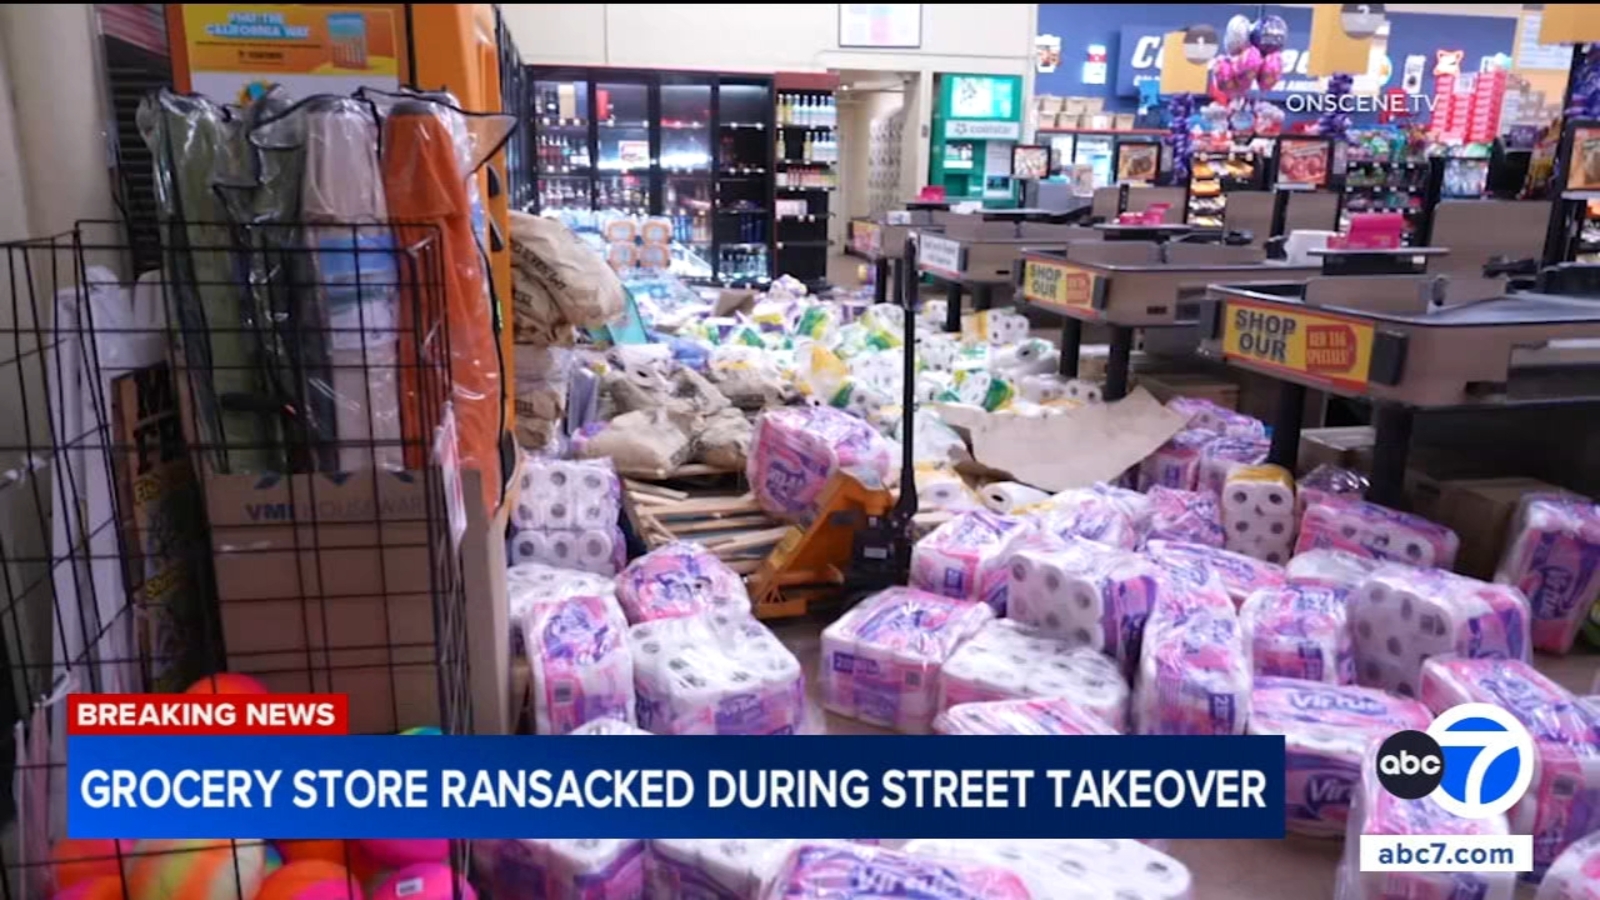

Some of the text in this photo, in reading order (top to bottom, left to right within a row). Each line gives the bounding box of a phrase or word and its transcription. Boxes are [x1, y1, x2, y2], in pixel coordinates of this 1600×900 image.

[1029, 263, 1062, 283] SHOP
[1032, 279, 1057, 299] OUR
[1235, 308, 1296, 336] SHOP
[1239, 332, 1287, 363] OUR
